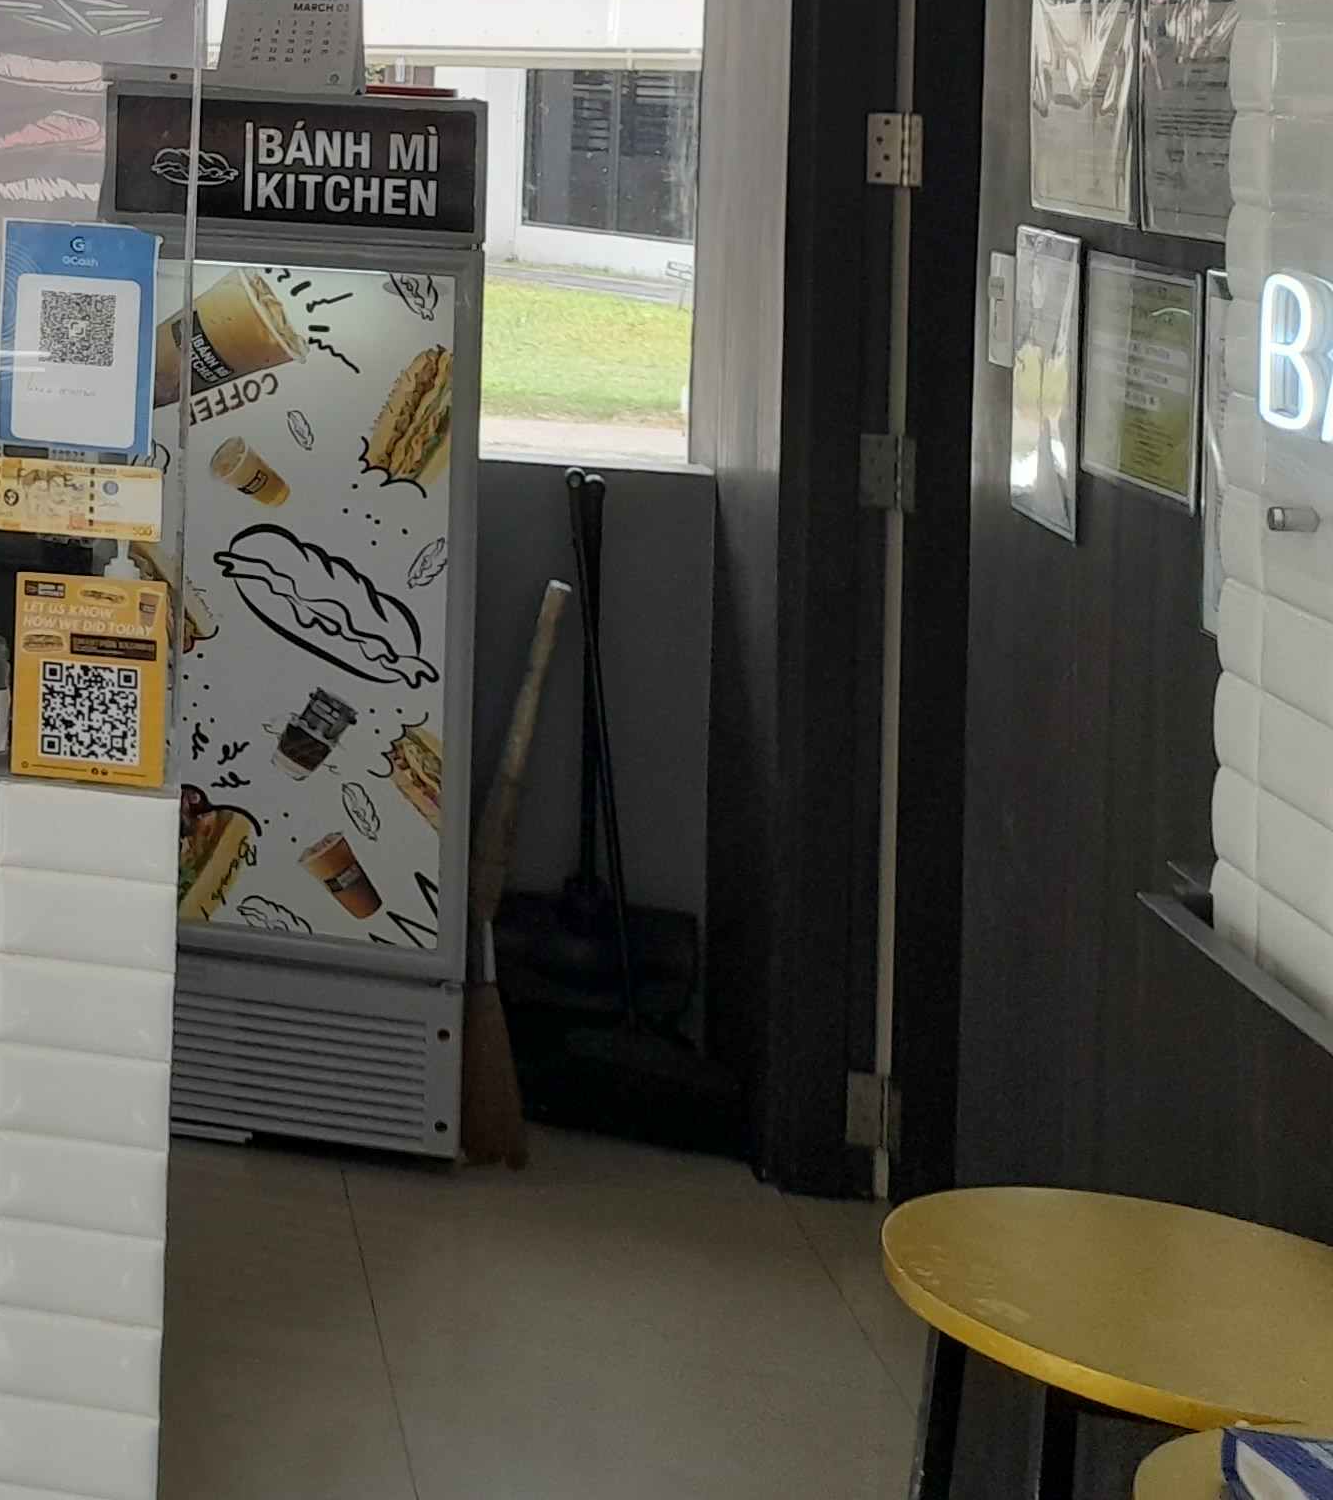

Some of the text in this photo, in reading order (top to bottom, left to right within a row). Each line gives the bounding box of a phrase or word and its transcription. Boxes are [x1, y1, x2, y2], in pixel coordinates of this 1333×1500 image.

[293, 2, 334, 13] MARCH
[257, 119, 439, 174] BÁNH MÌ
[256, 171, 438, 218] KITCHEN
[23, 602, 114, 619] LET US KNOW
[23, 615, 153, 638] HOW WE DID TODAY
